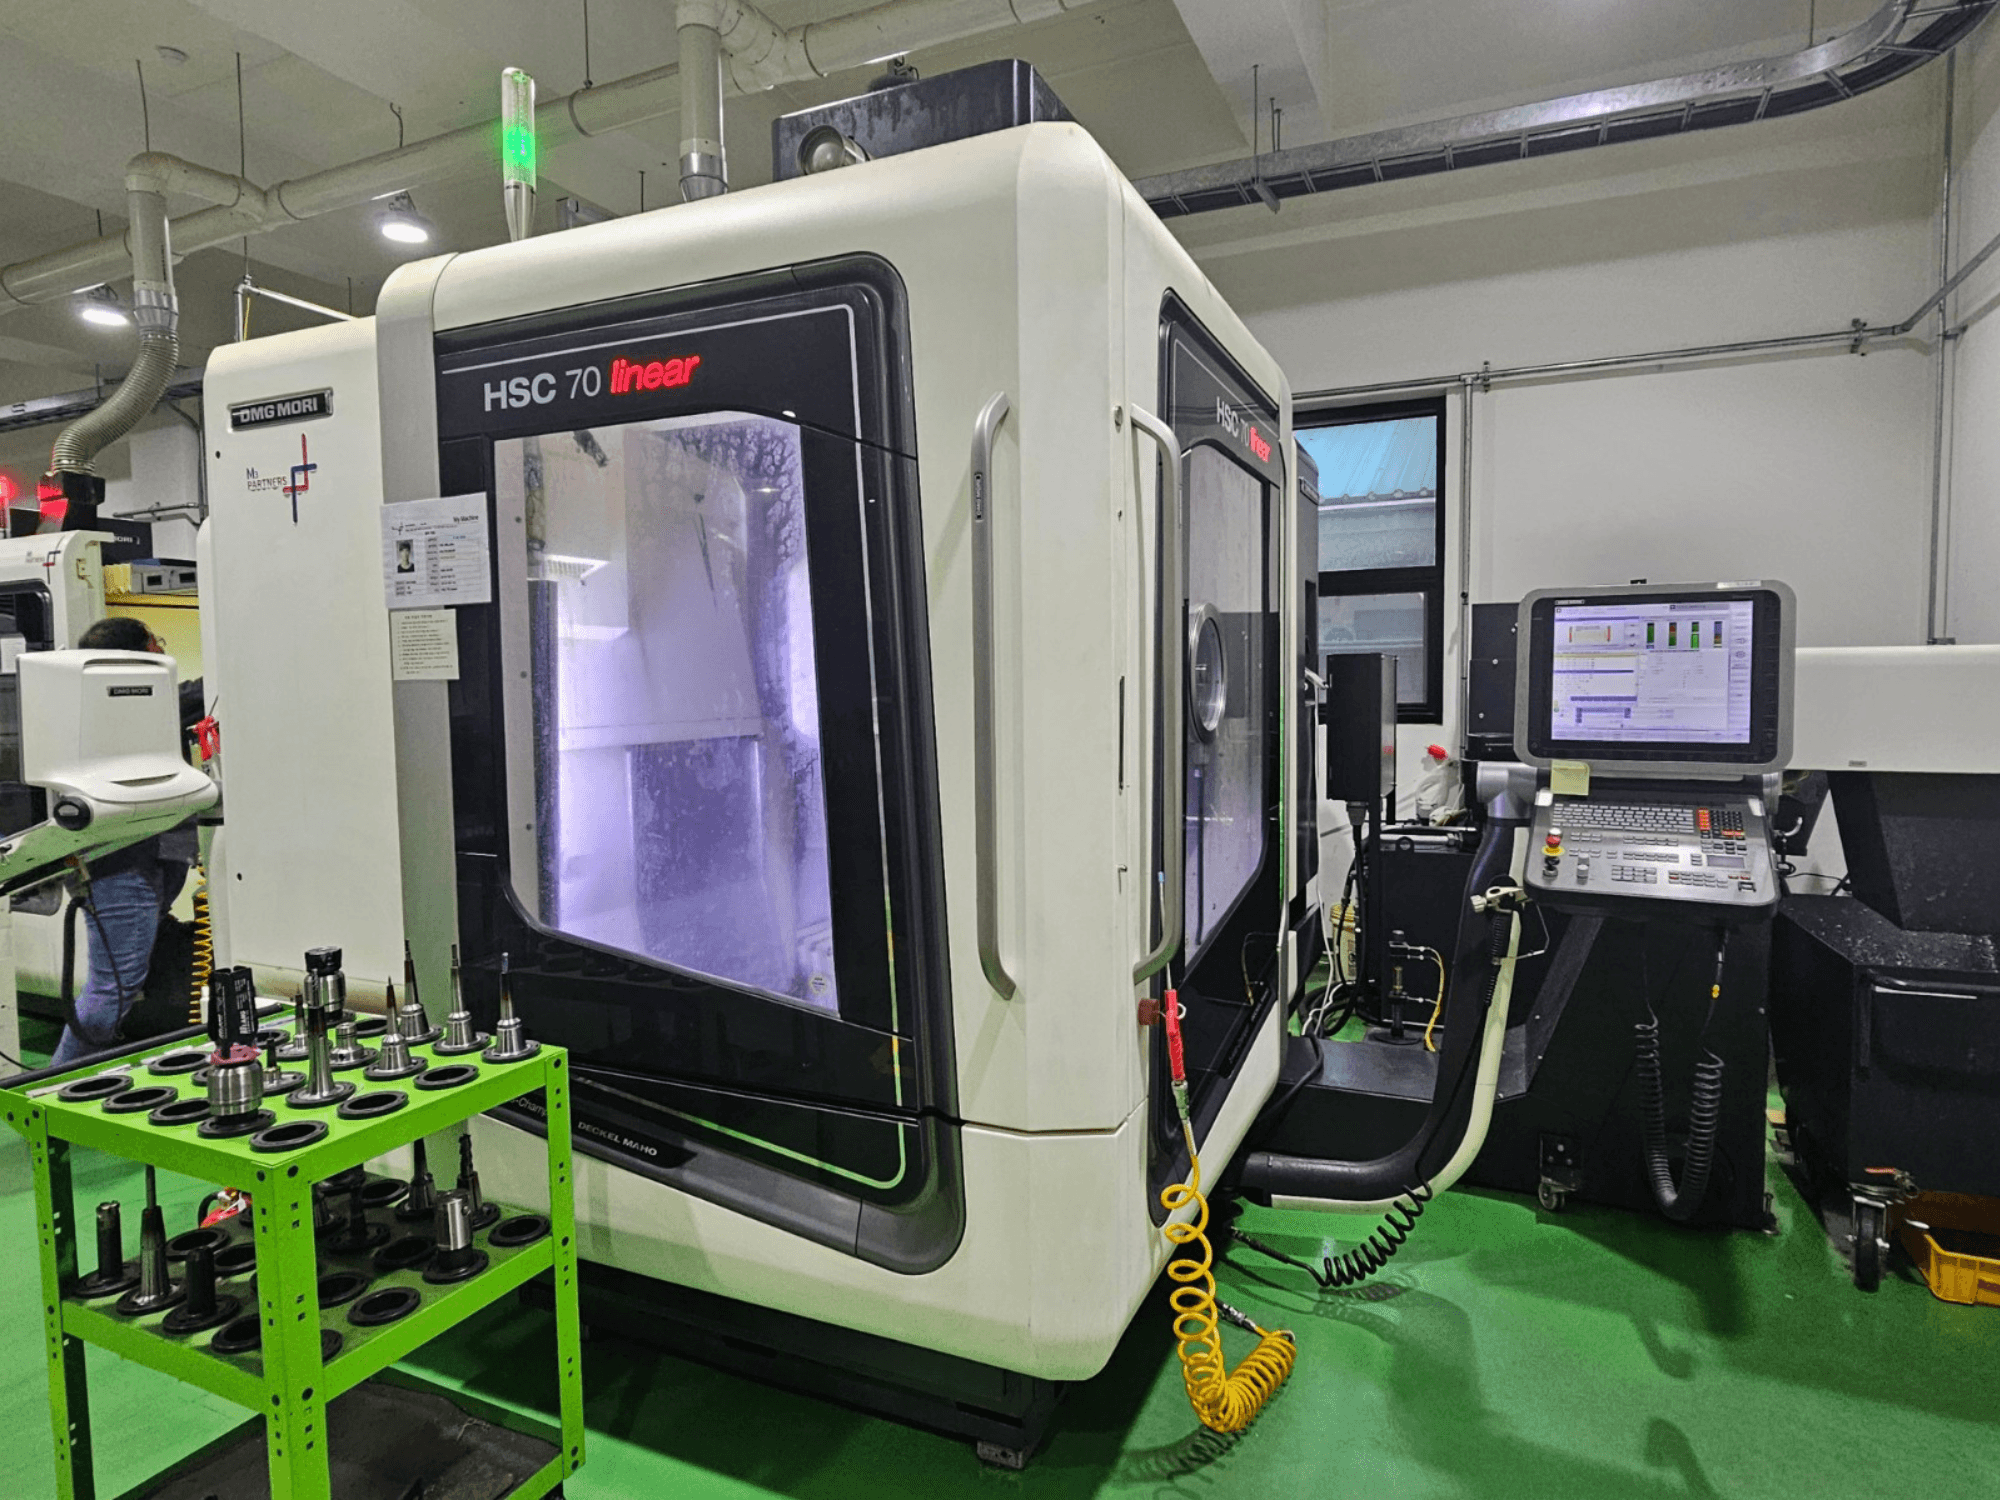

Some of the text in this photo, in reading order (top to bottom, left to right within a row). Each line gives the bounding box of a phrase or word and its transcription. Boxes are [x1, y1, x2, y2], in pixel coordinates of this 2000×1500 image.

[483, 354, 701, 412] HSC 70 linear
[240, 397, 319, 423] DMG MORI
[1216, 396, 1240, 438] HSC
[247, 476, 288, 491] PARTNERS
[577, 1121, 621, 1143] DECKEL
[622, 1137, 658, 1156] MAHO
